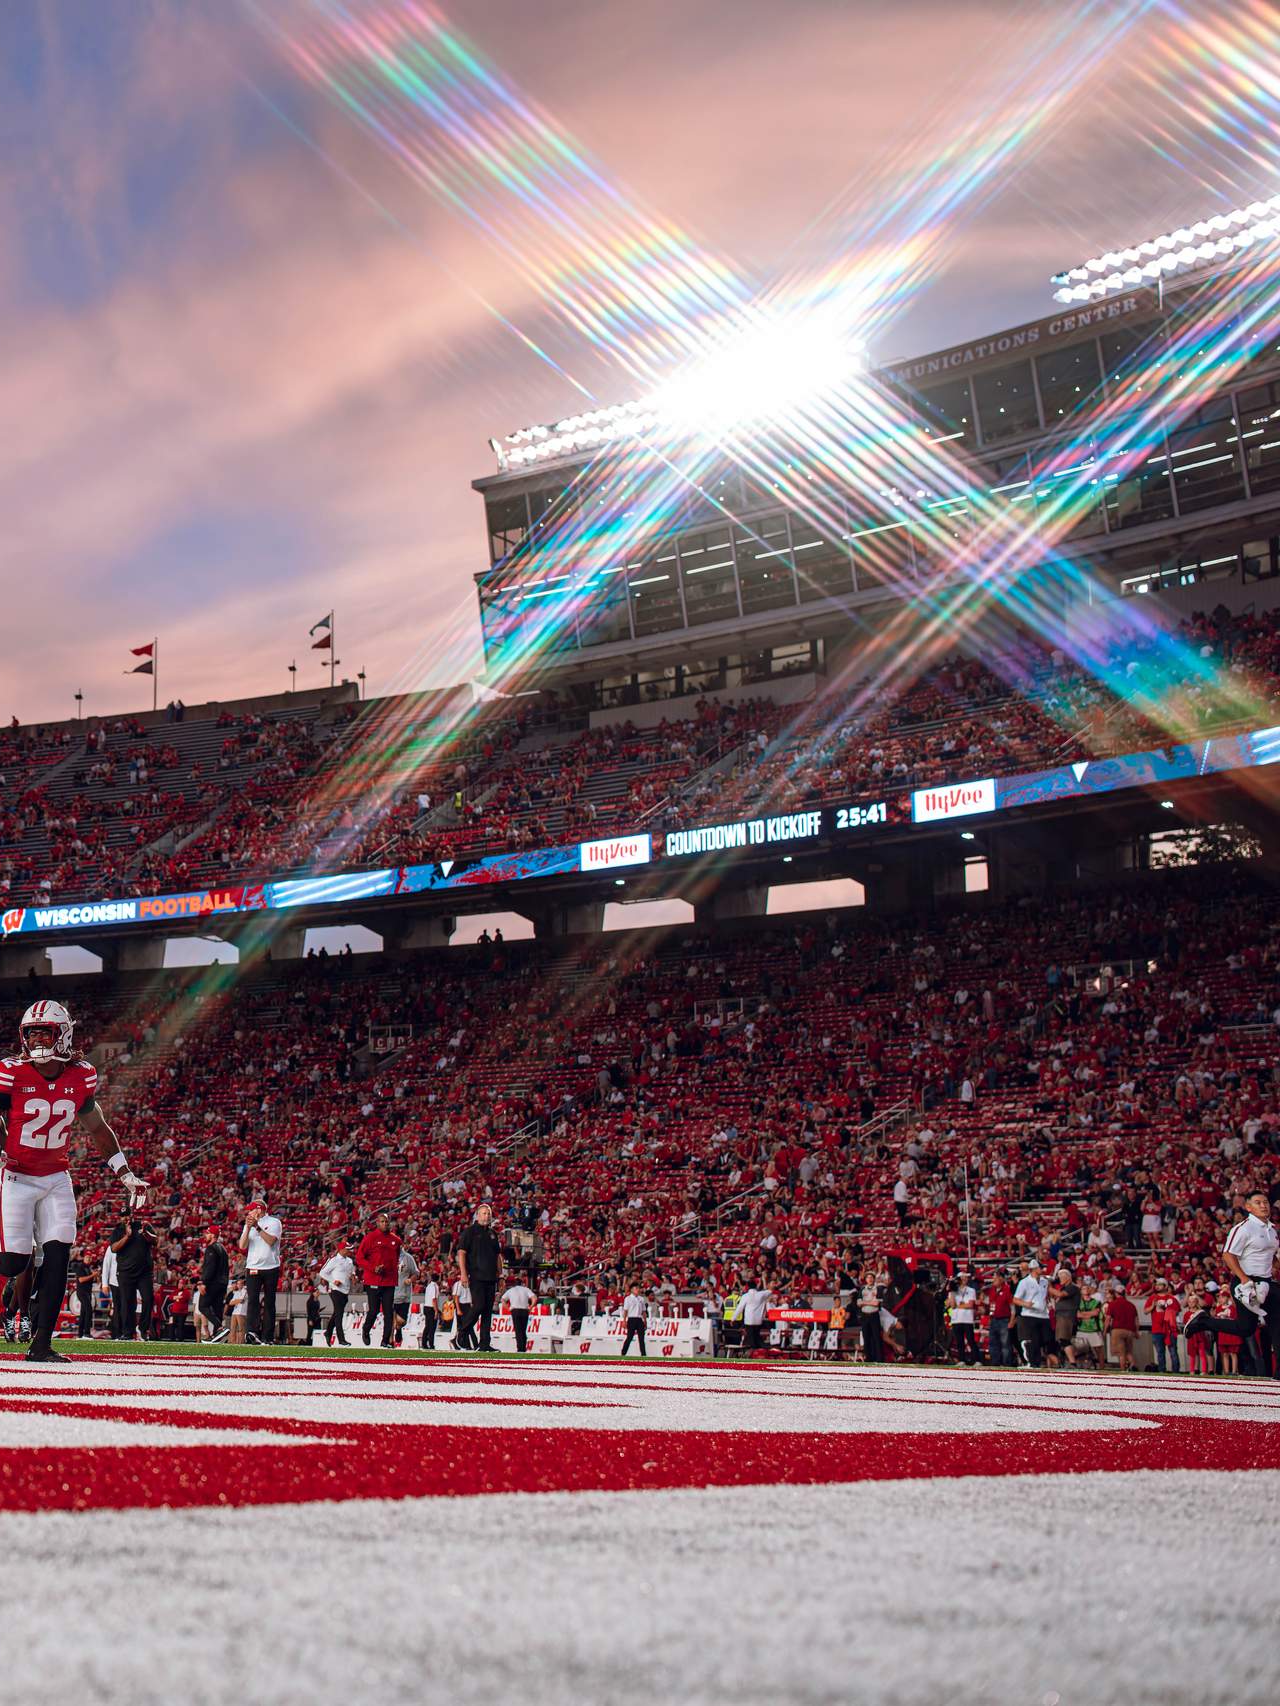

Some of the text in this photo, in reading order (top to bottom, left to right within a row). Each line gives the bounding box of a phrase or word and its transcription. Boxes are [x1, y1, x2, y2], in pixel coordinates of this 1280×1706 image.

[1048, 297, 1139, 336] CENTER
[924, 788, 983, 813] HyVee
[666, 801, 887, 857] COUNTDOWN TO KICKOFF 25:41
[589, 843, 638, 864] HyVee
[34, 902, 136, 928] WISCONSIN
[140, 892, 235, 918] FOOTBALL
[19, 1098, 76, 1150] 22
[780, 1311, 815, 1319] GATORADE
